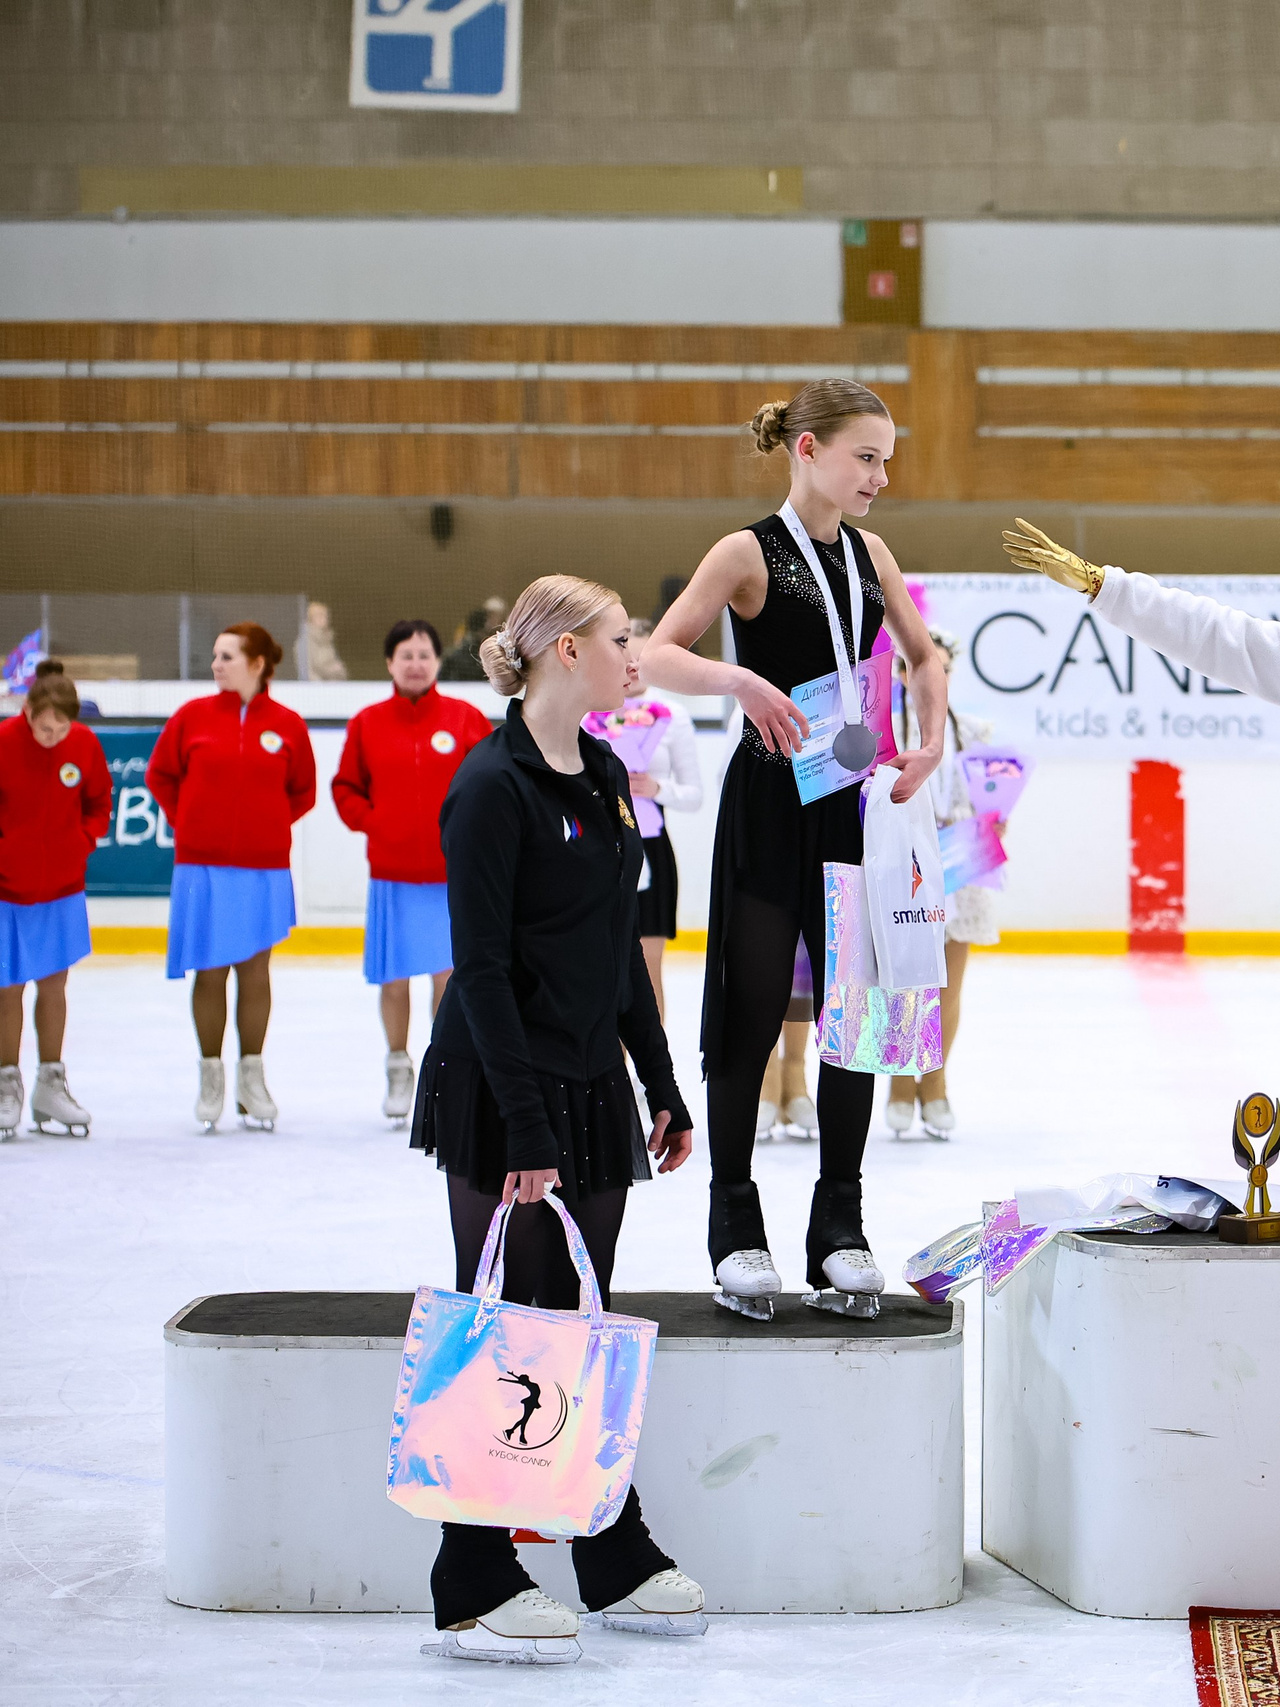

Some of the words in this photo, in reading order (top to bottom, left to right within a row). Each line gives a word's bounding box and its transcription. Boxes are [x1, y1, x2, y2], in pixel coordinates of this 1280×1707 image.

[1035, 707, 1109, 739] kids
[1120, 710, 1146, 739] &
[1159, 709, 1263, 739] teens
[893, 904, 946, 924] smartavia
[488, 1448, 520, 1462] КУБОК
[520, 1455, 552, 1467] CANDY
